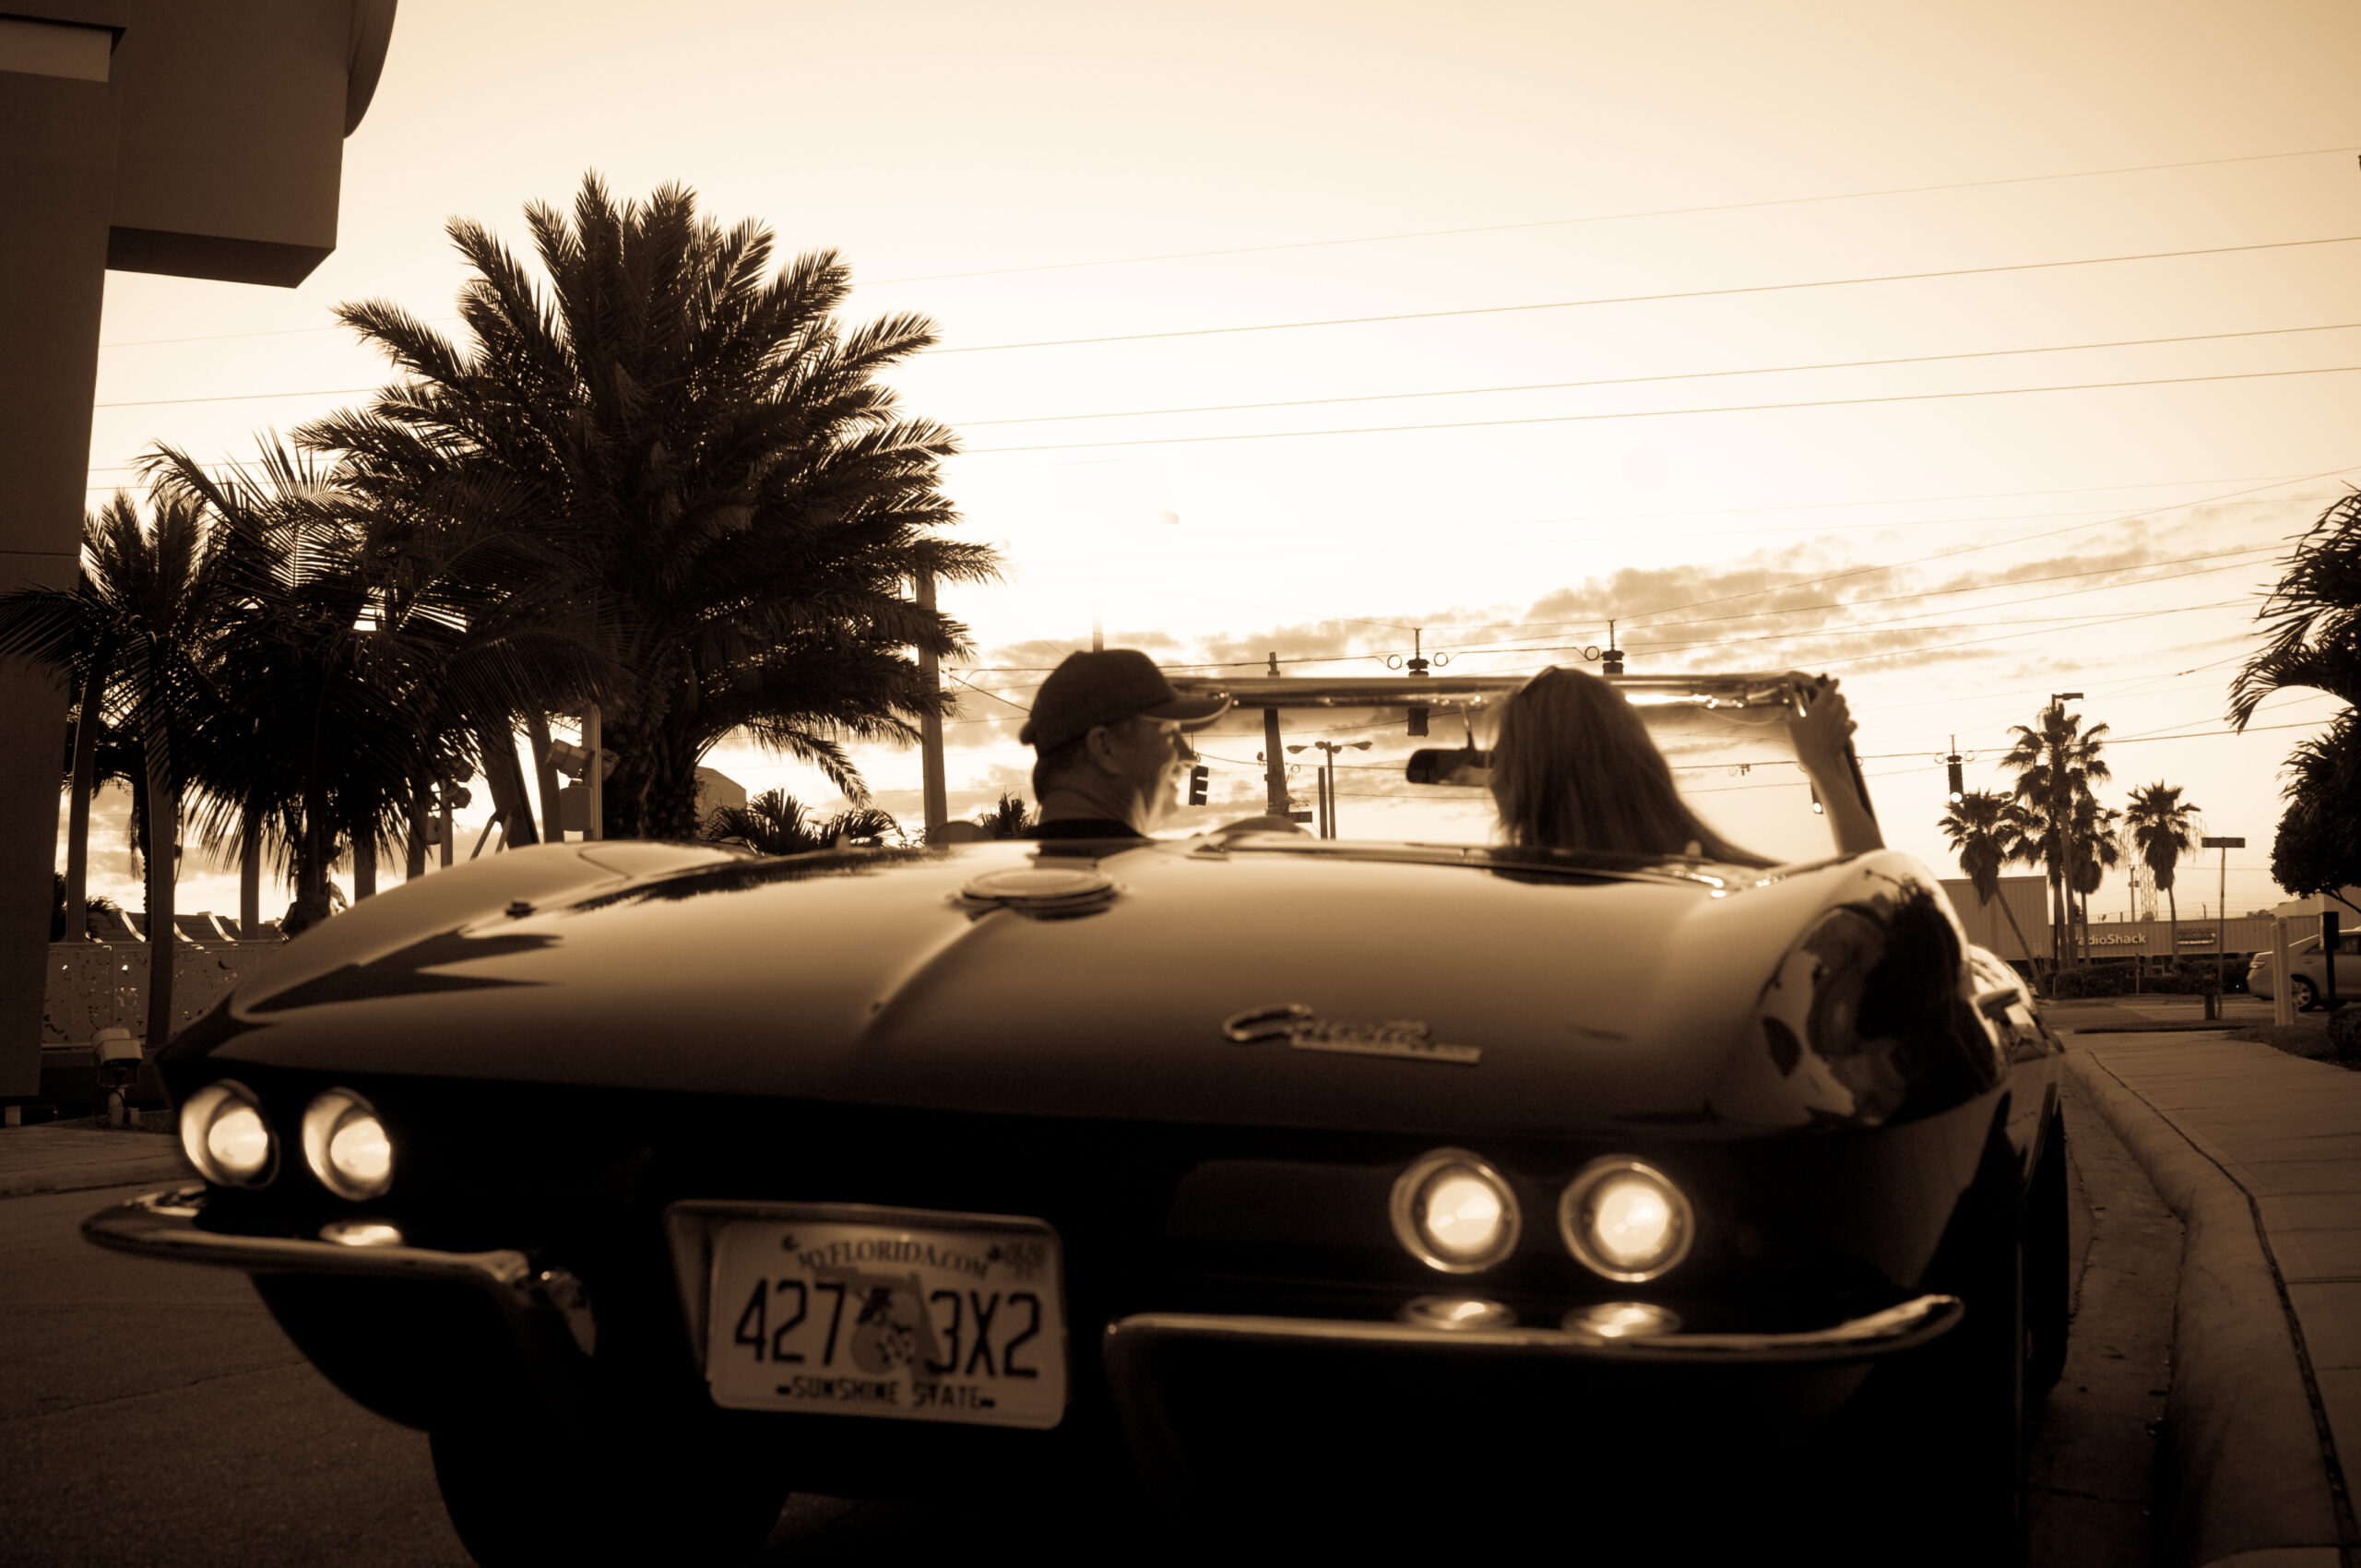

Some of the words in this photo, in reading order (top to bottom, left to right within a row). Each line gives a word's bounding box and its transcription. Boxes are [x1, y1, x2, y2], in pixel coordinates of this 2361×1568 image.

[2075, 933, 2146, 945] adioShack
[734, 1278, 846, 1366] 427
[923, 1289, 1041, 1379] 3X2
[793, 1375, 900, 1405] SUNSHINE
[911, 1382, 981, 1409] STATE
